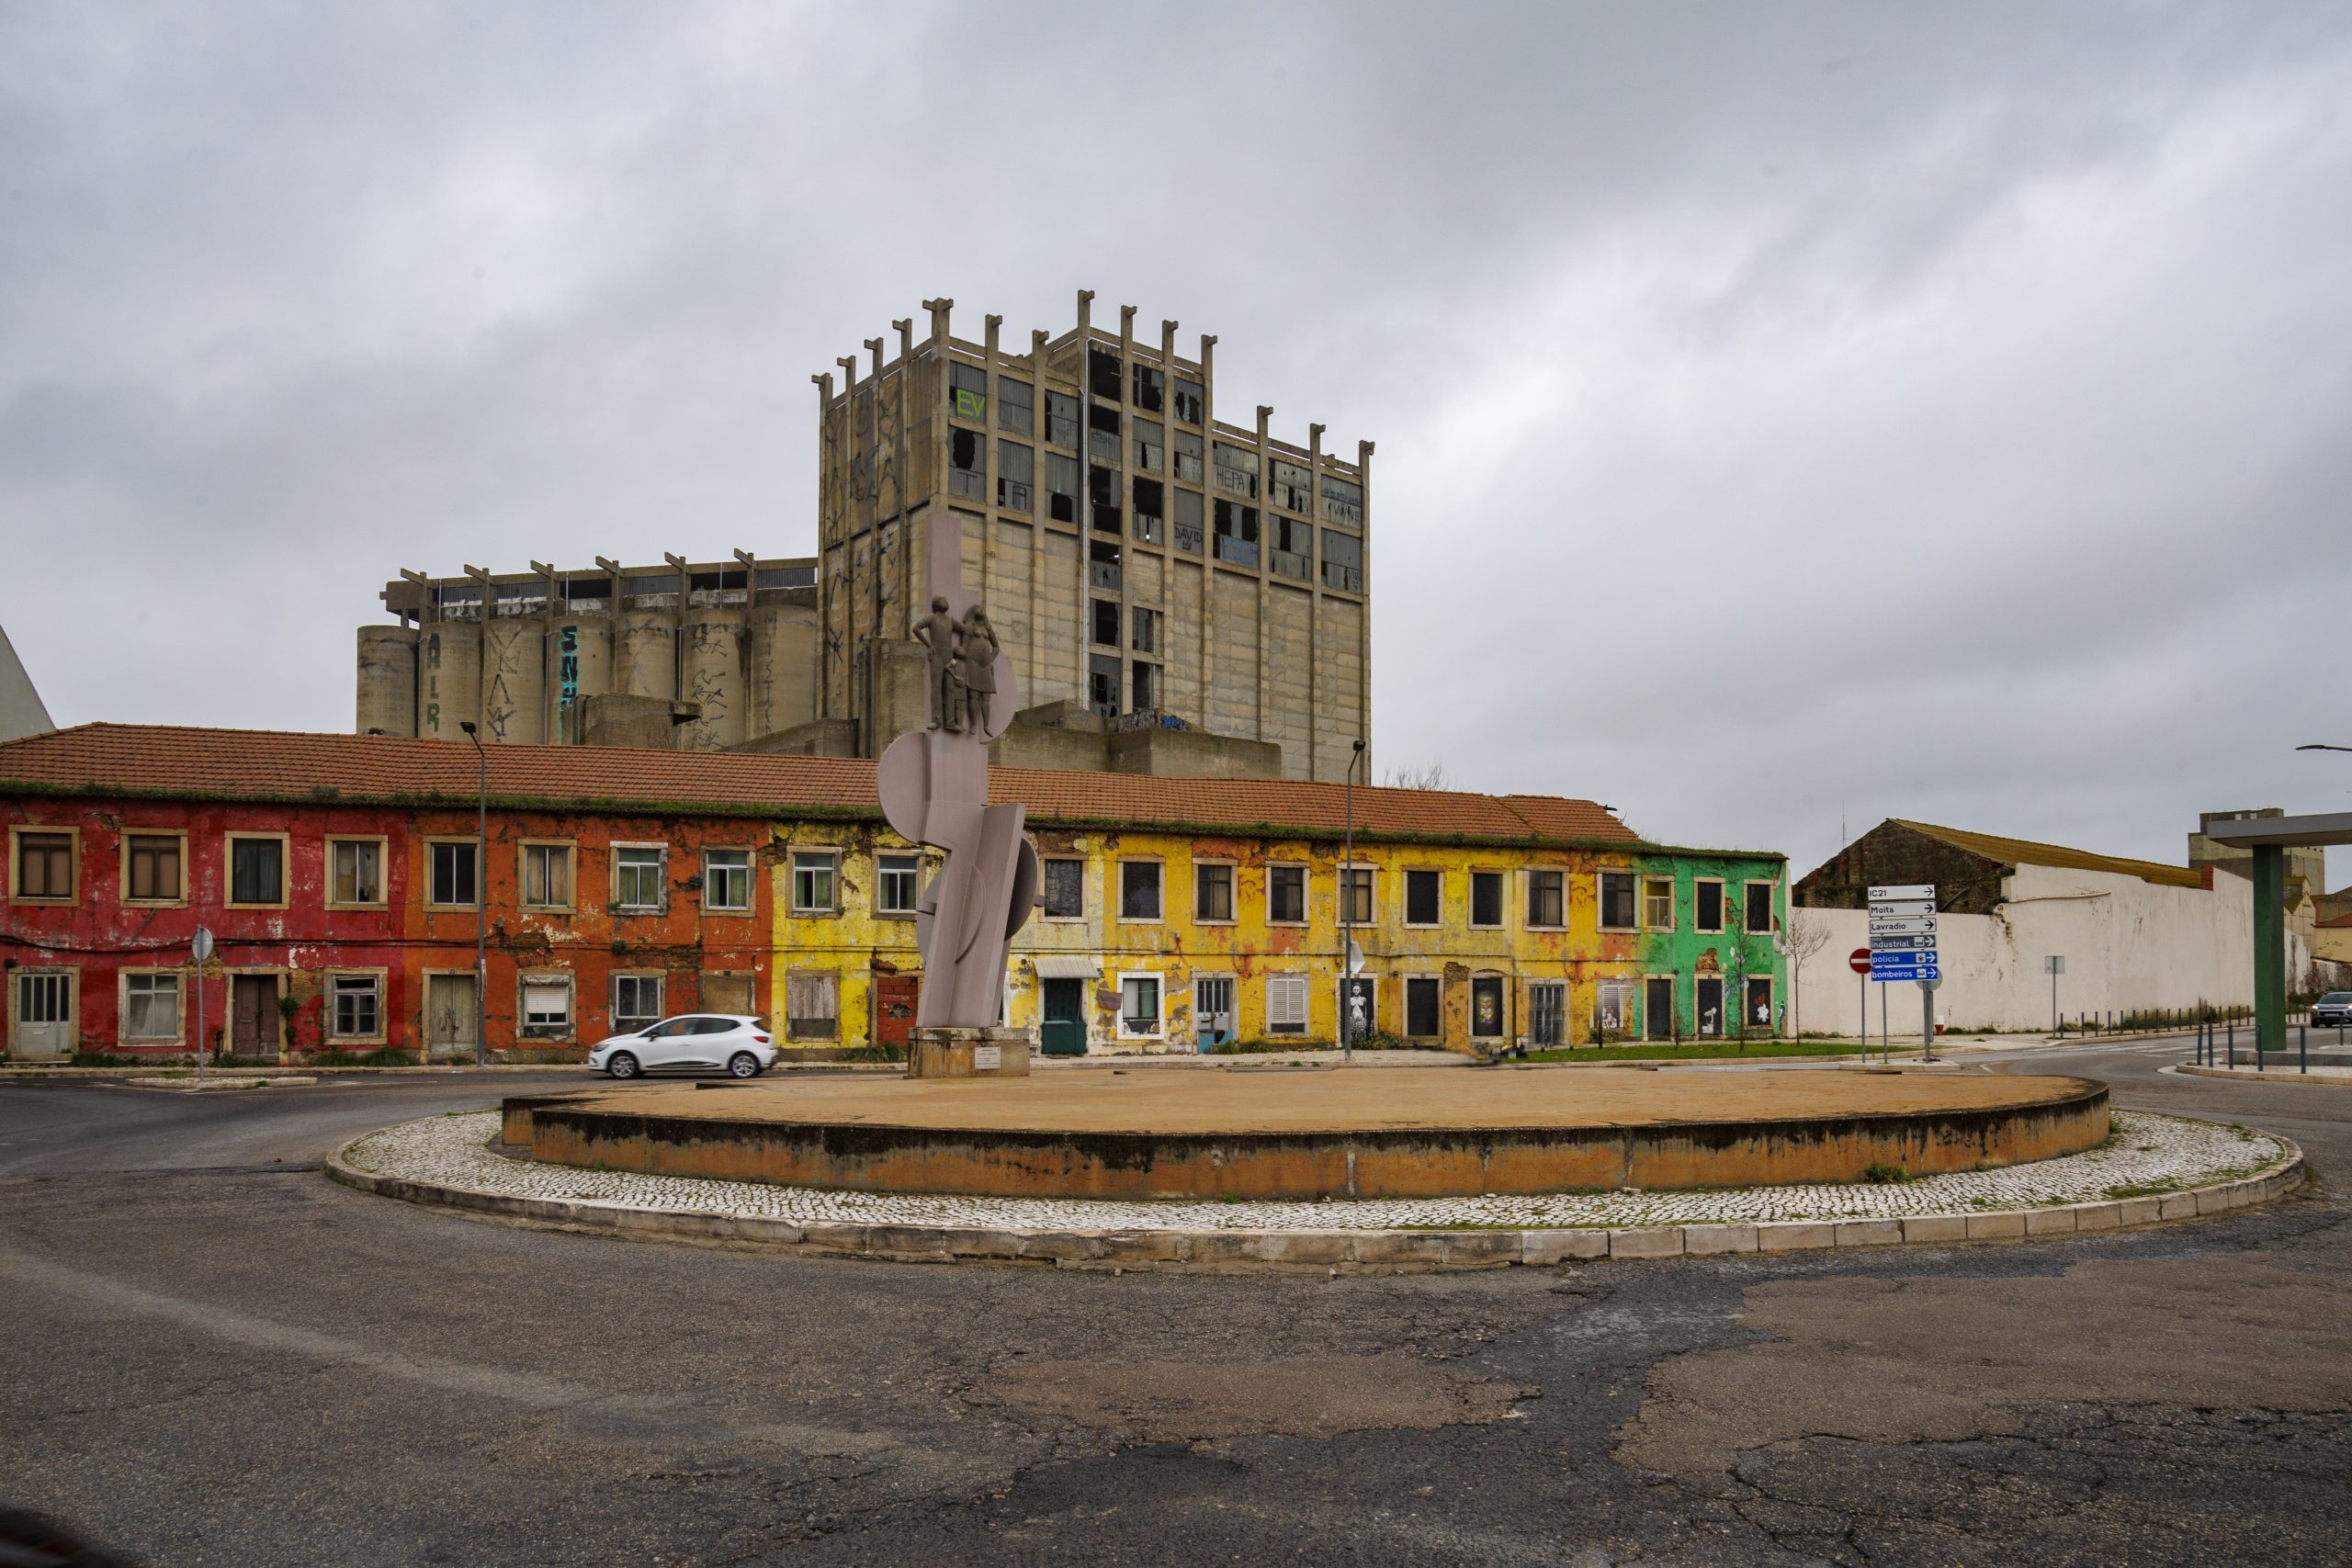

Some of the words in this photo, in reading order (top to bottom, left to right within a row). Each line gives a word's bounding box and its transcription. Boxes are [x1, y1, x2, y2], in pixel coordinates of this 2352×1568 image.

[956, 389, 986, 421] EV
[1174, 526, 1203, 544] DAVID
[1869, 889, 1887, 897] IC21
[1871, 906, 1894, 914] Moita
[1871, 922, 1906, 931] Lavradio
[1871, 940, 1910, 948] industrial
[1871, 970, 1913, 978] bombeiros
